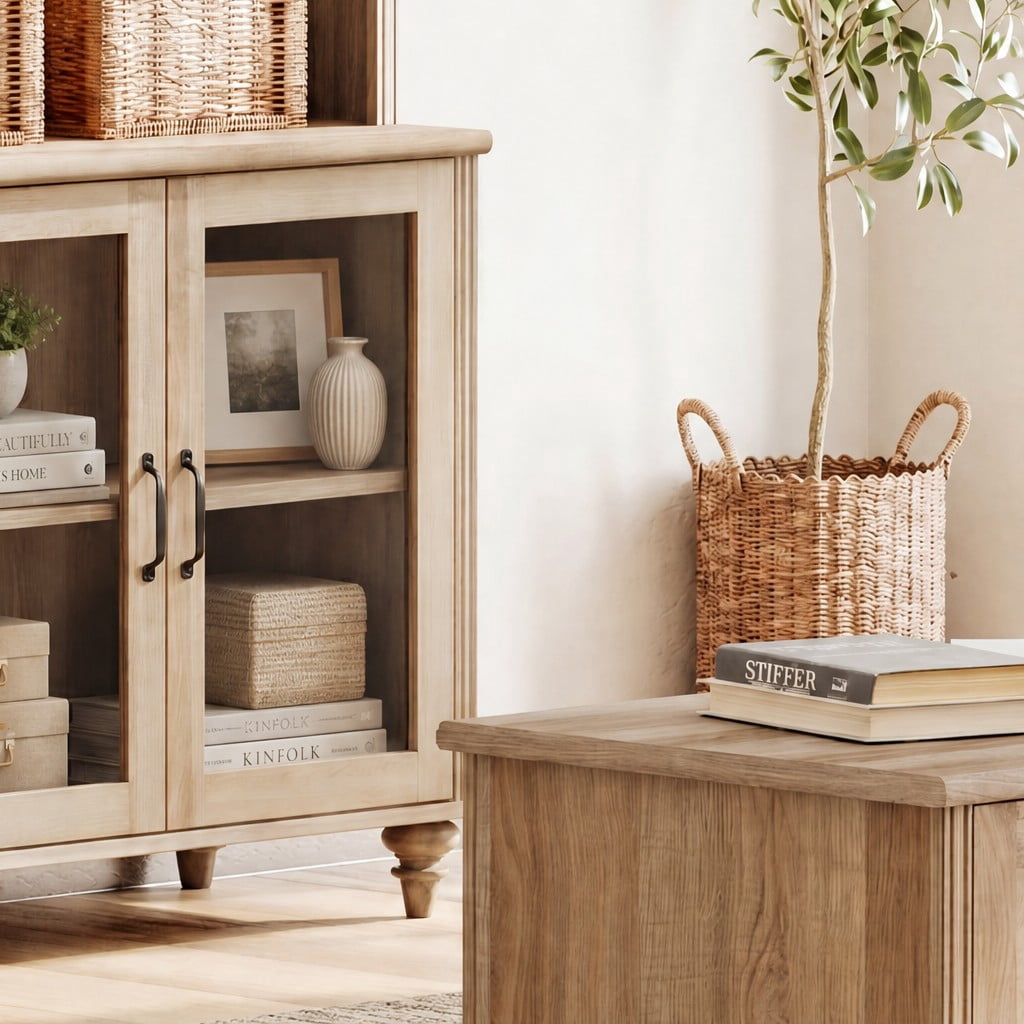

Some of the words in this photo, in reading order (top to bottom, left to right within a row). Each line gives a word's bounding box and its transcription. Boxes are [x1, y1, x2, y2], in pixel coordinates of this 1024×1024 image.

[11, 467, 47, 481] HOME
[745, 659, 817, 691] STIFFER
[244, 715, 311, 734] KINFOLK
[243, 745, 320, 767] KINFOLK
